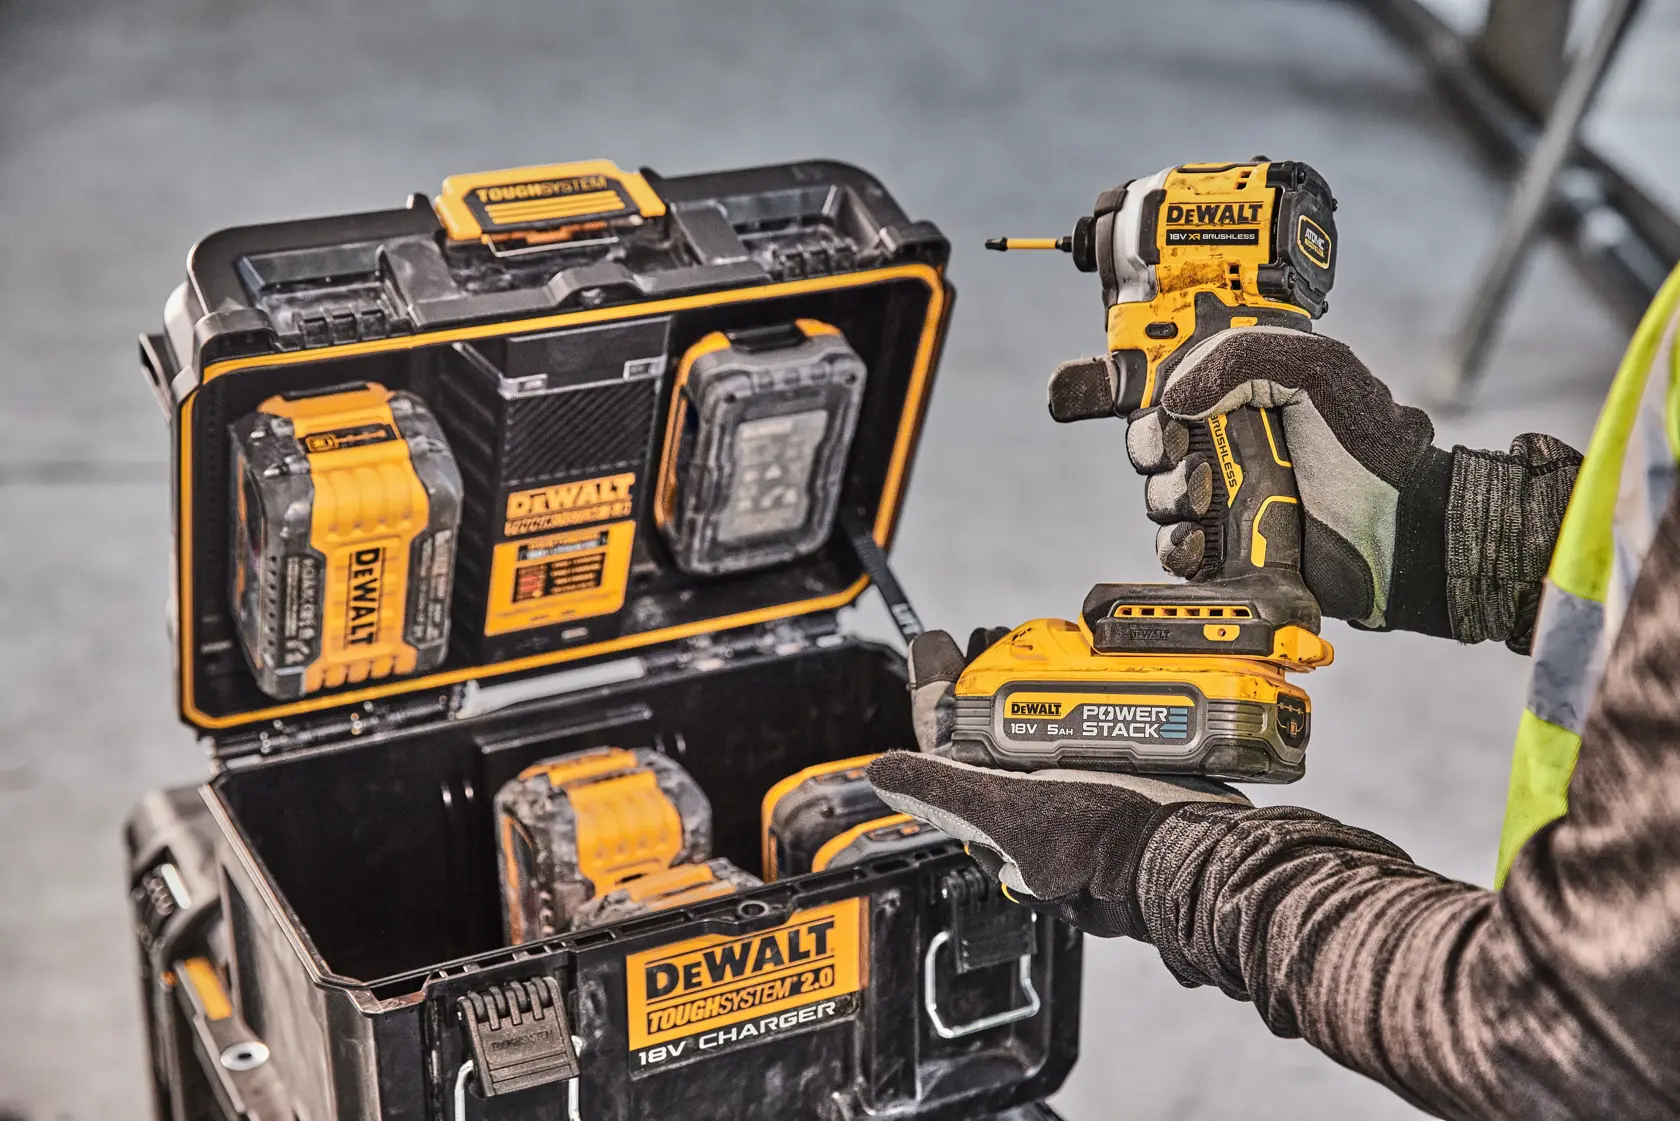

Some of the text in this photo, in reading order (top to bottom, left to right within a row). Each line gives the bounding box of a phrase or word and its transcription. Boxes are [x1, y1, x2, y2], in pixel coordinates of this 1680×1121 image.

[476, 175, 608, 203] TOUGHSYSTEM
[1166, 204, 1264, 224] DEWALT
[1169, 233, 1187, 241] 18V
[1188, 233, 1201, 241] XR
[349, 547, 381, 645] DEWALT
[1011, 703, 1062, 715] DEWALT
[1083, 706, 1168, 722] POWER
[1010, 723, 1038, 735] 18V
[1083, 722, 1160, 738] STACK
[645, 920, 835, 1001] DEWALT
[800, 966, 834, 993] 2.0
[638, 1001, 837, 1066] 18V CHARGER
